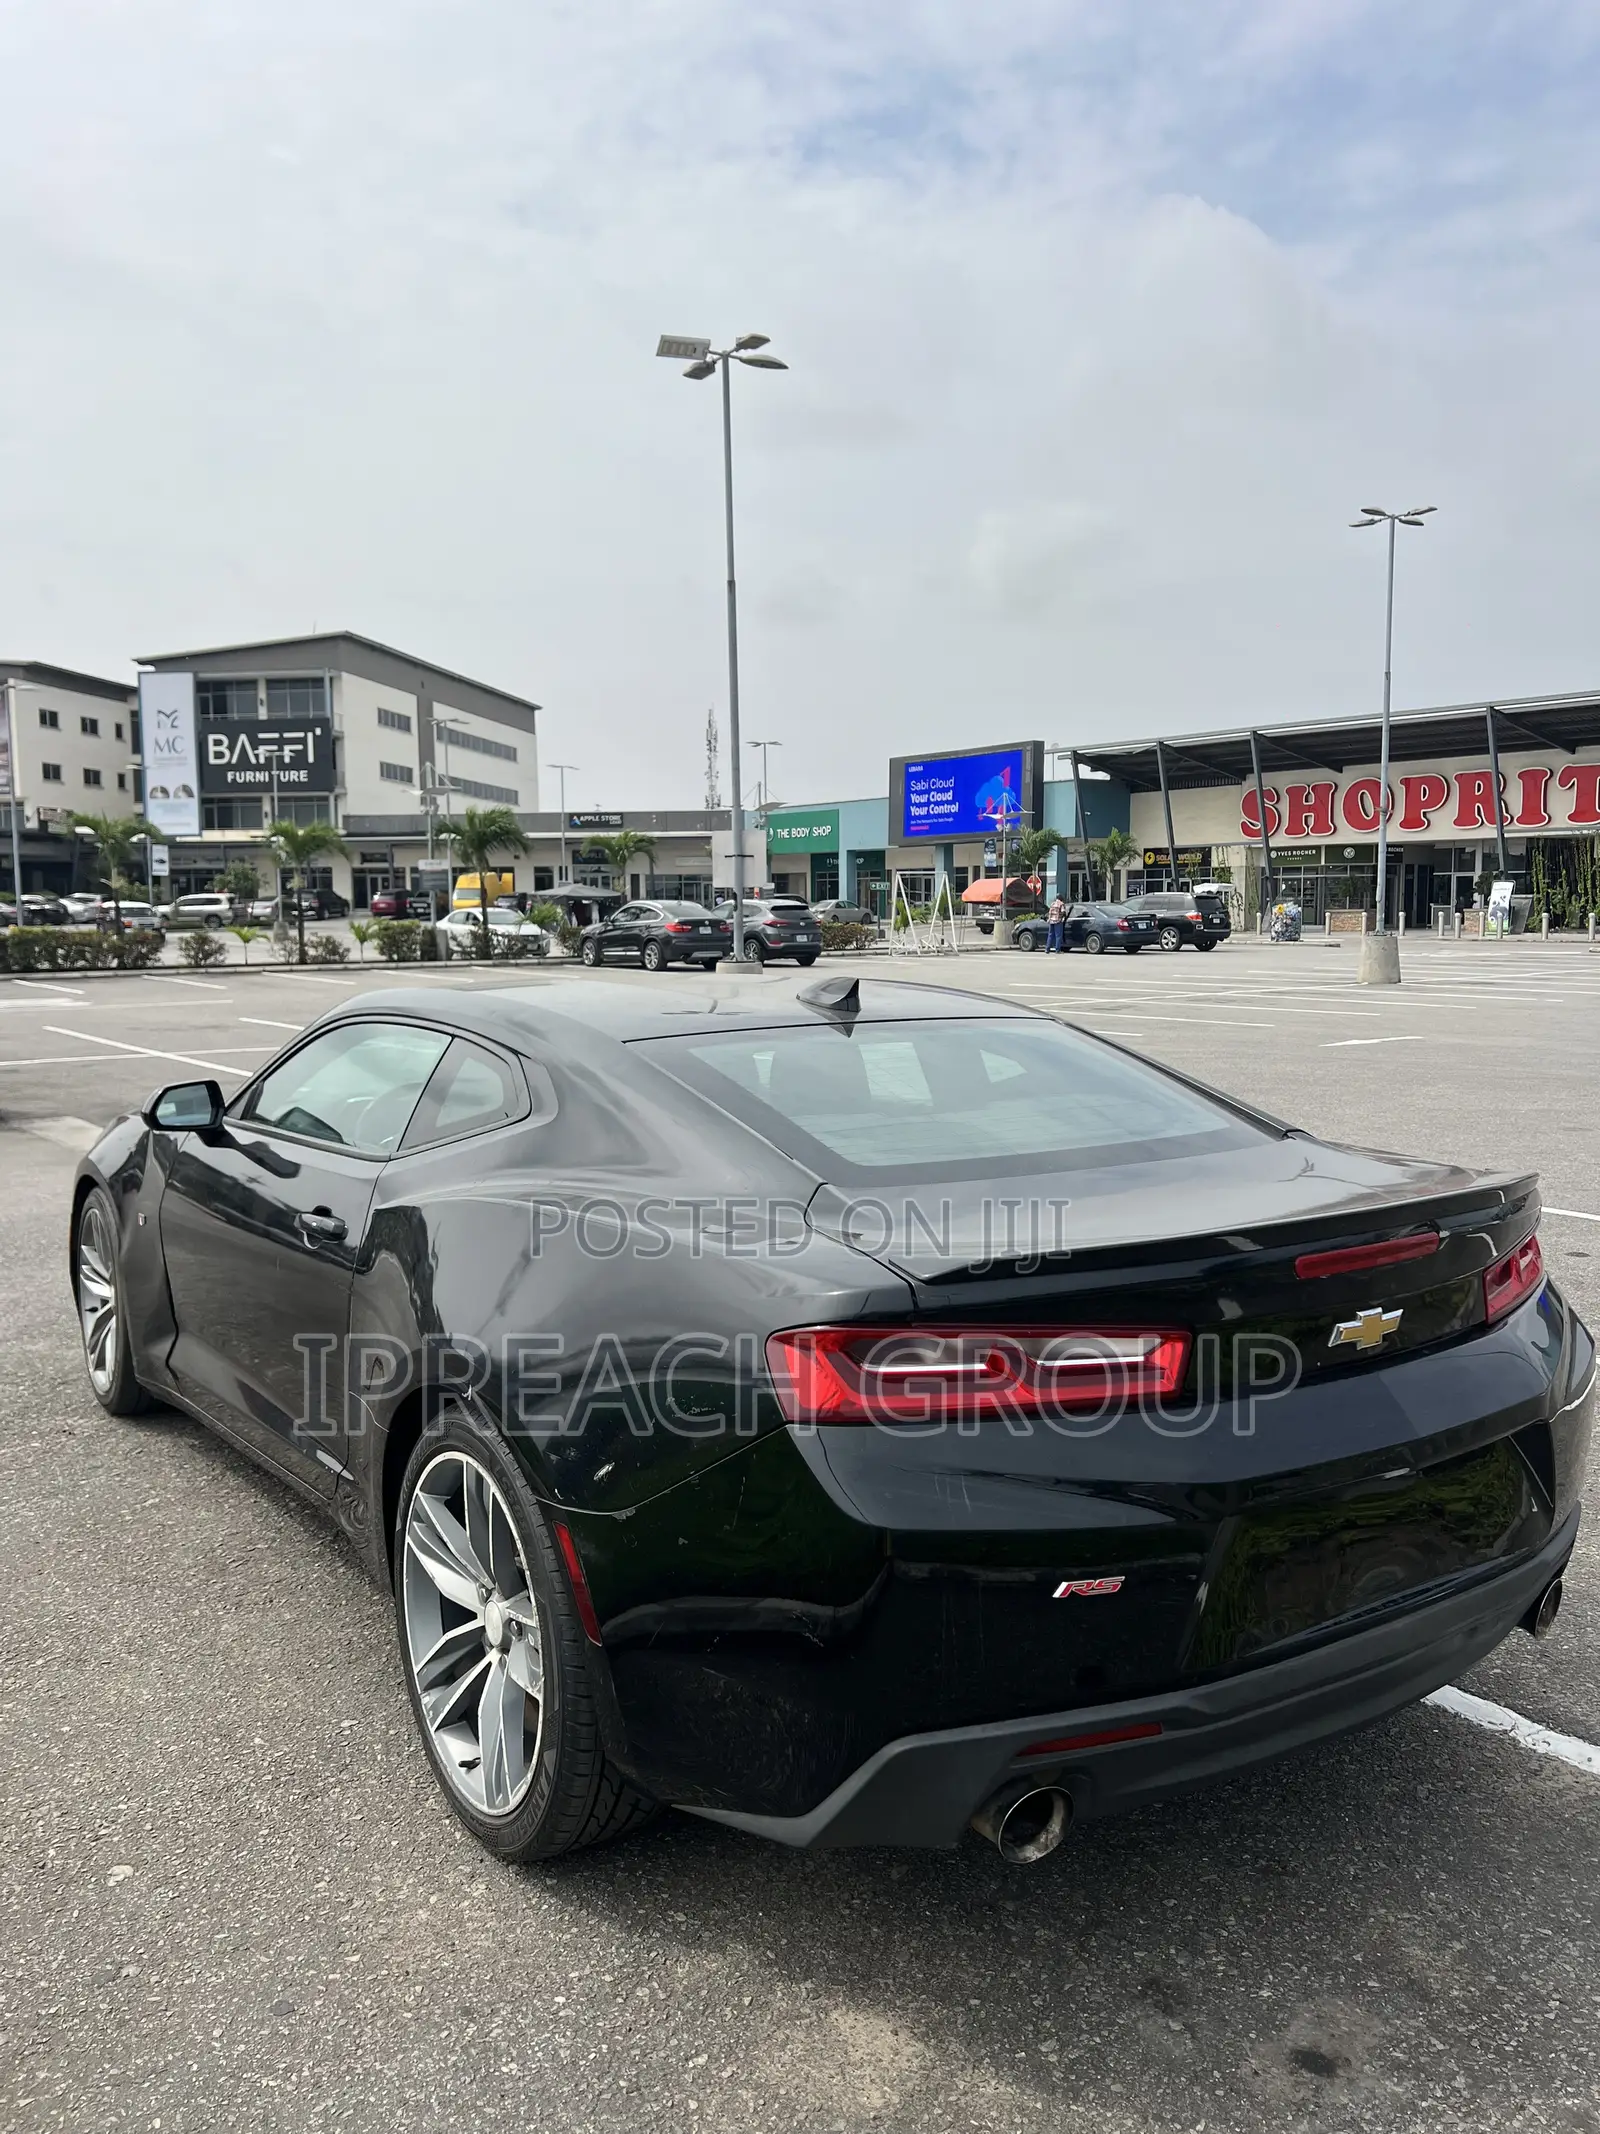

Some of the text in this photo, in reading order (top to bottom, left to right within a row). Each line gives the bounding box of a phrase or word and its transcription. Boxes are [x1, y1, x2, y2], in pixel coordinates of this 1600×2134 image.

[153, 735, 185, 755] MC
[910, 776, 955, 791] Sabi Cloud
[910, 789, 953, 803] Your Cloud
[910, 801, 959, 816] Your Control
[776, 825, 832, 838] THE BODY SHOP
[1052, 1576, 1126, 1598] RS
